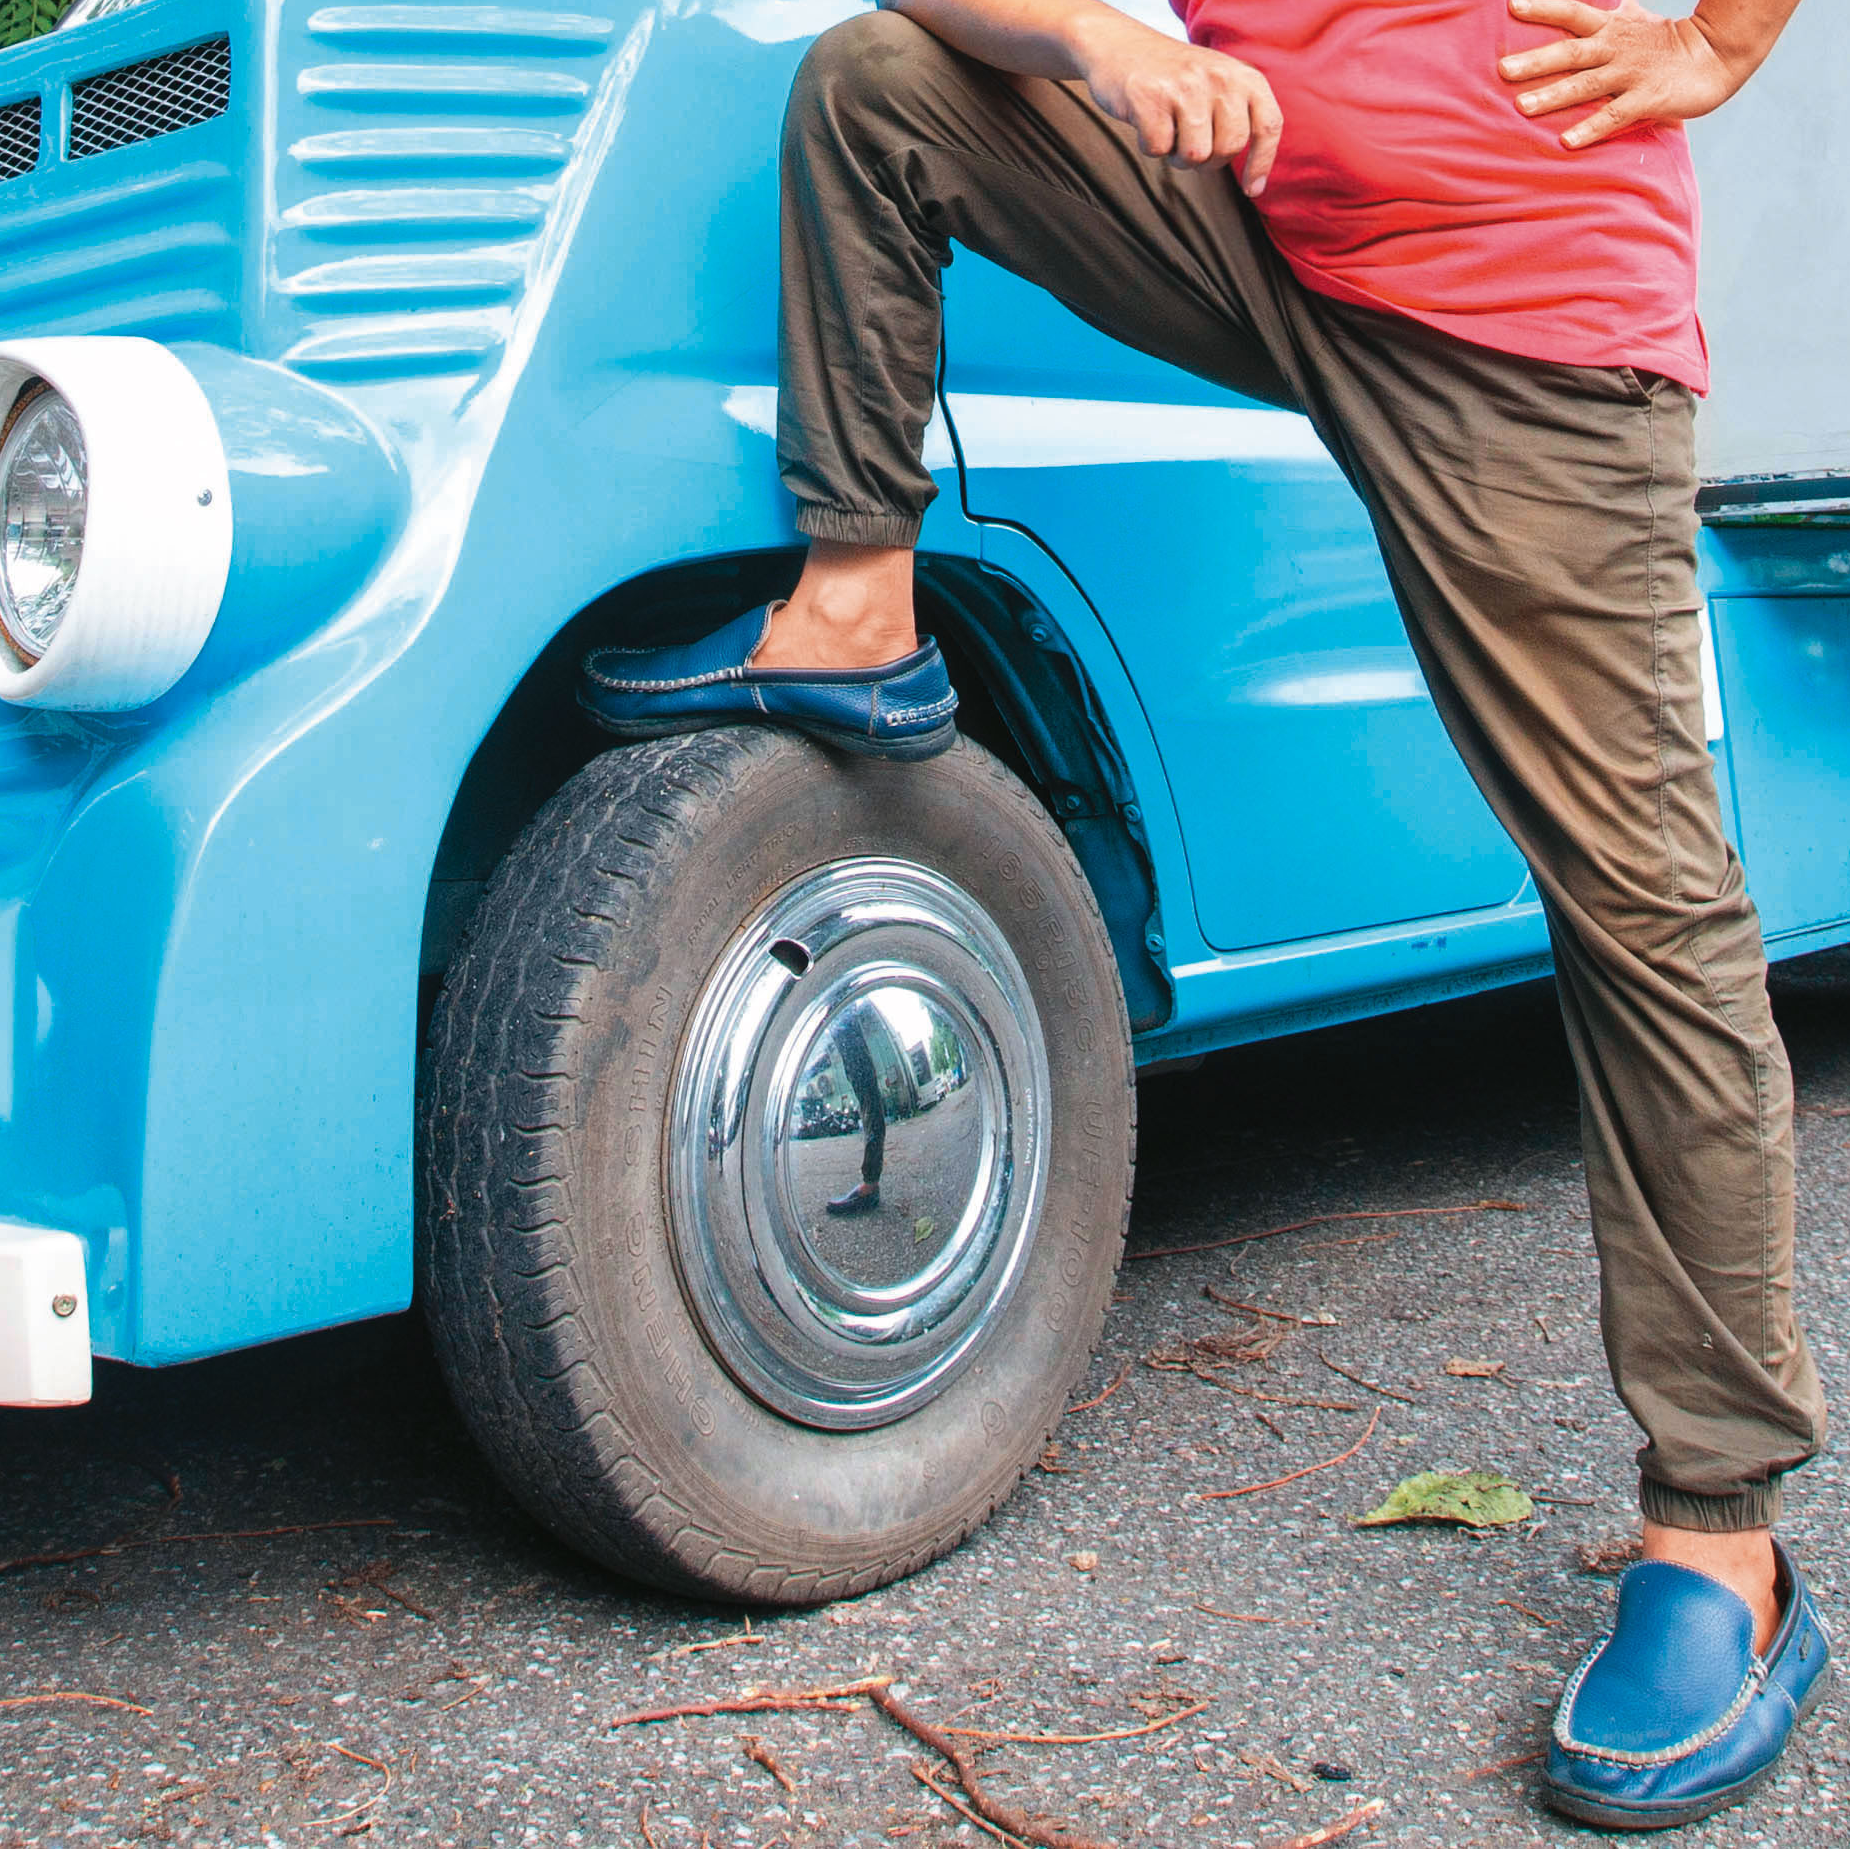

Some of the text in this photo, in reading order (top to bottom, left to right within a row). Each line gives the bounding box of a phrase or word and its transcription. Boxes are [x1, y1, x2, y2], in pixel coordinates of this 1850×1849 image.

[687, 821, 802, 945] RADIAL LIGHT TRUCK
[623, 985, 717, 1437] CHENG SHIN
